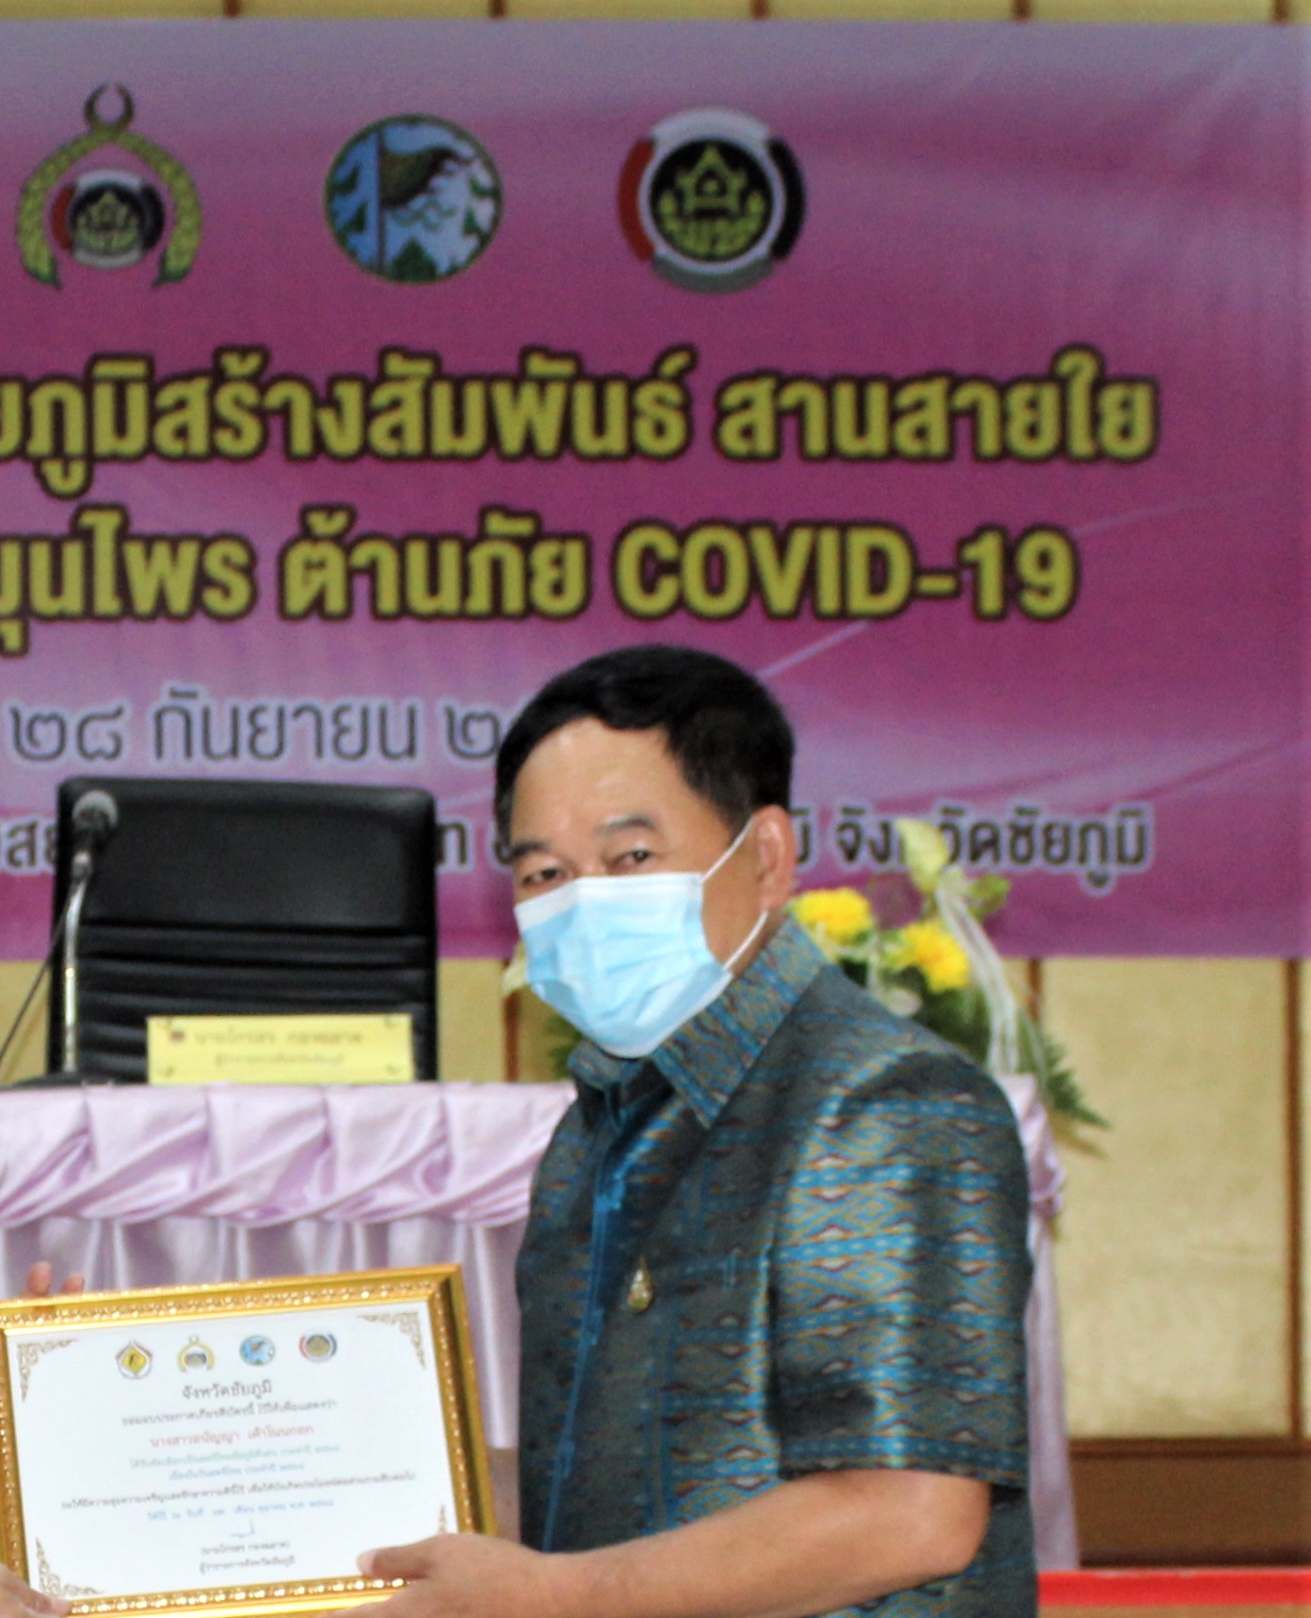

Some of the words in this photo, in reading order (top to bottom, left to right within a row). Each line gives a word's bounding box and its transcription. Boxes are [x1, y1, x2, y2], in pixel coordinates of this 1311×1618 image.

[715, 342, 1160, 463] สานสายใย
[280, 504, 591, 621] ต้านภัย
[612, 518, 1080, 623] COVID-19
[8, 705, 124, 762] ๒๘
[151, 687, 418, 762] กันยายน
[835, 806, 1147, 888] จังวัดชัยภูมิ
